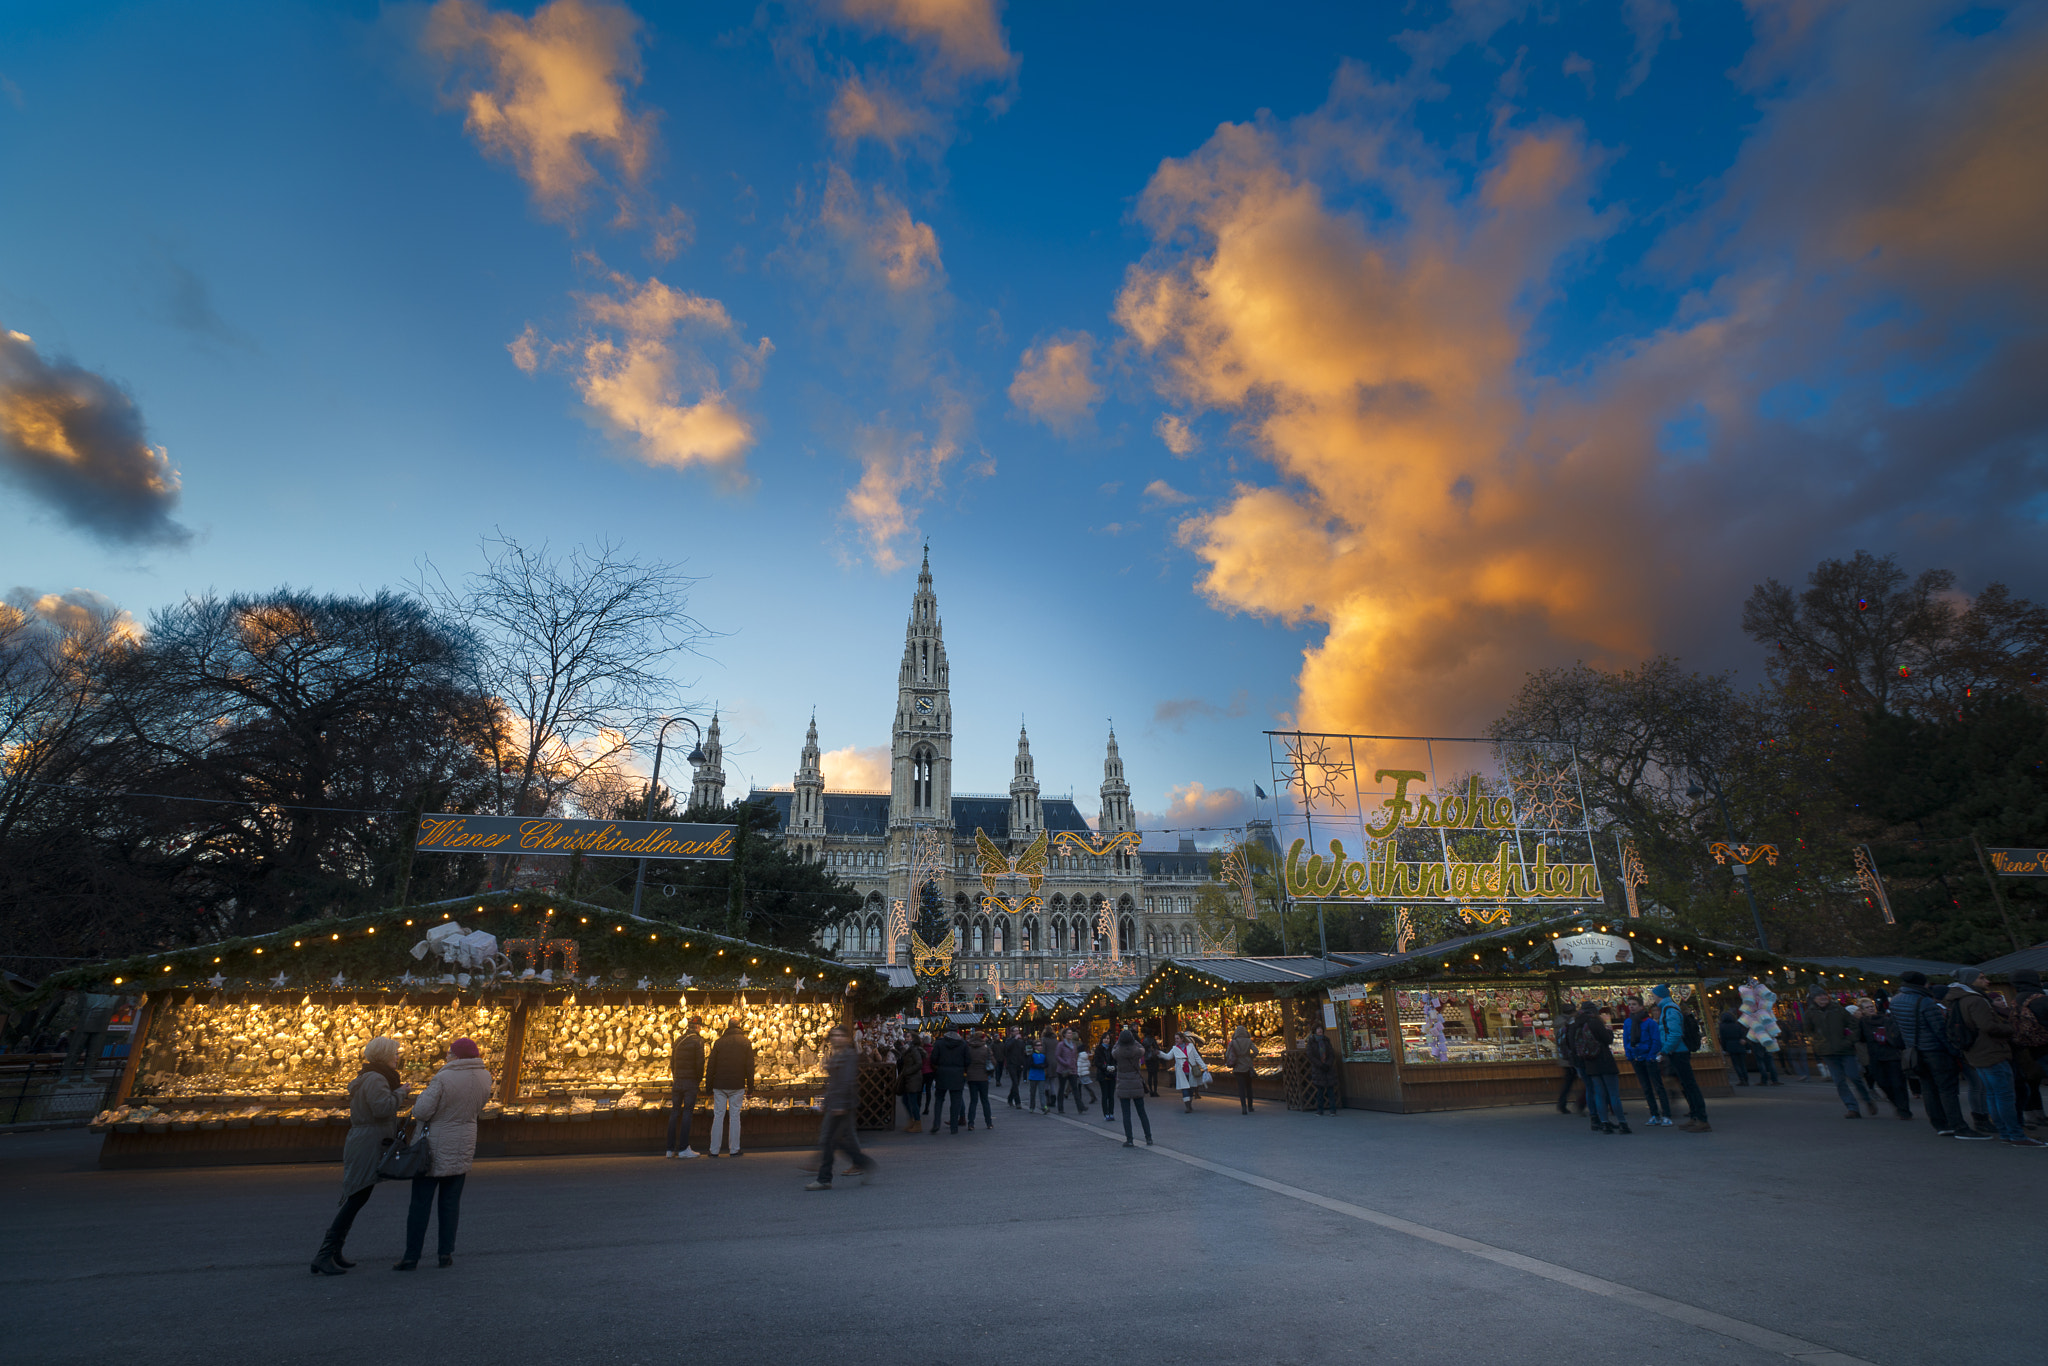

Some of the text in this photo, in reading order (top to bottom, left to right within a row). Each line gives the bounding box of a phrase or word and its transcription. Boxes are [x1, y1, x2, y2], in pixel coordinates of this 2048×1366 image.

[1365, 769, 1516, 838] Frohe
[417, 818, 736, 856] Wiener Christkindlmarkt
[1285, 838, 1604, 899] Weihnachten
[1990, 851, 2038, 873] Wiener
[1565, 937, 1616, 949] NASCHKATZE
